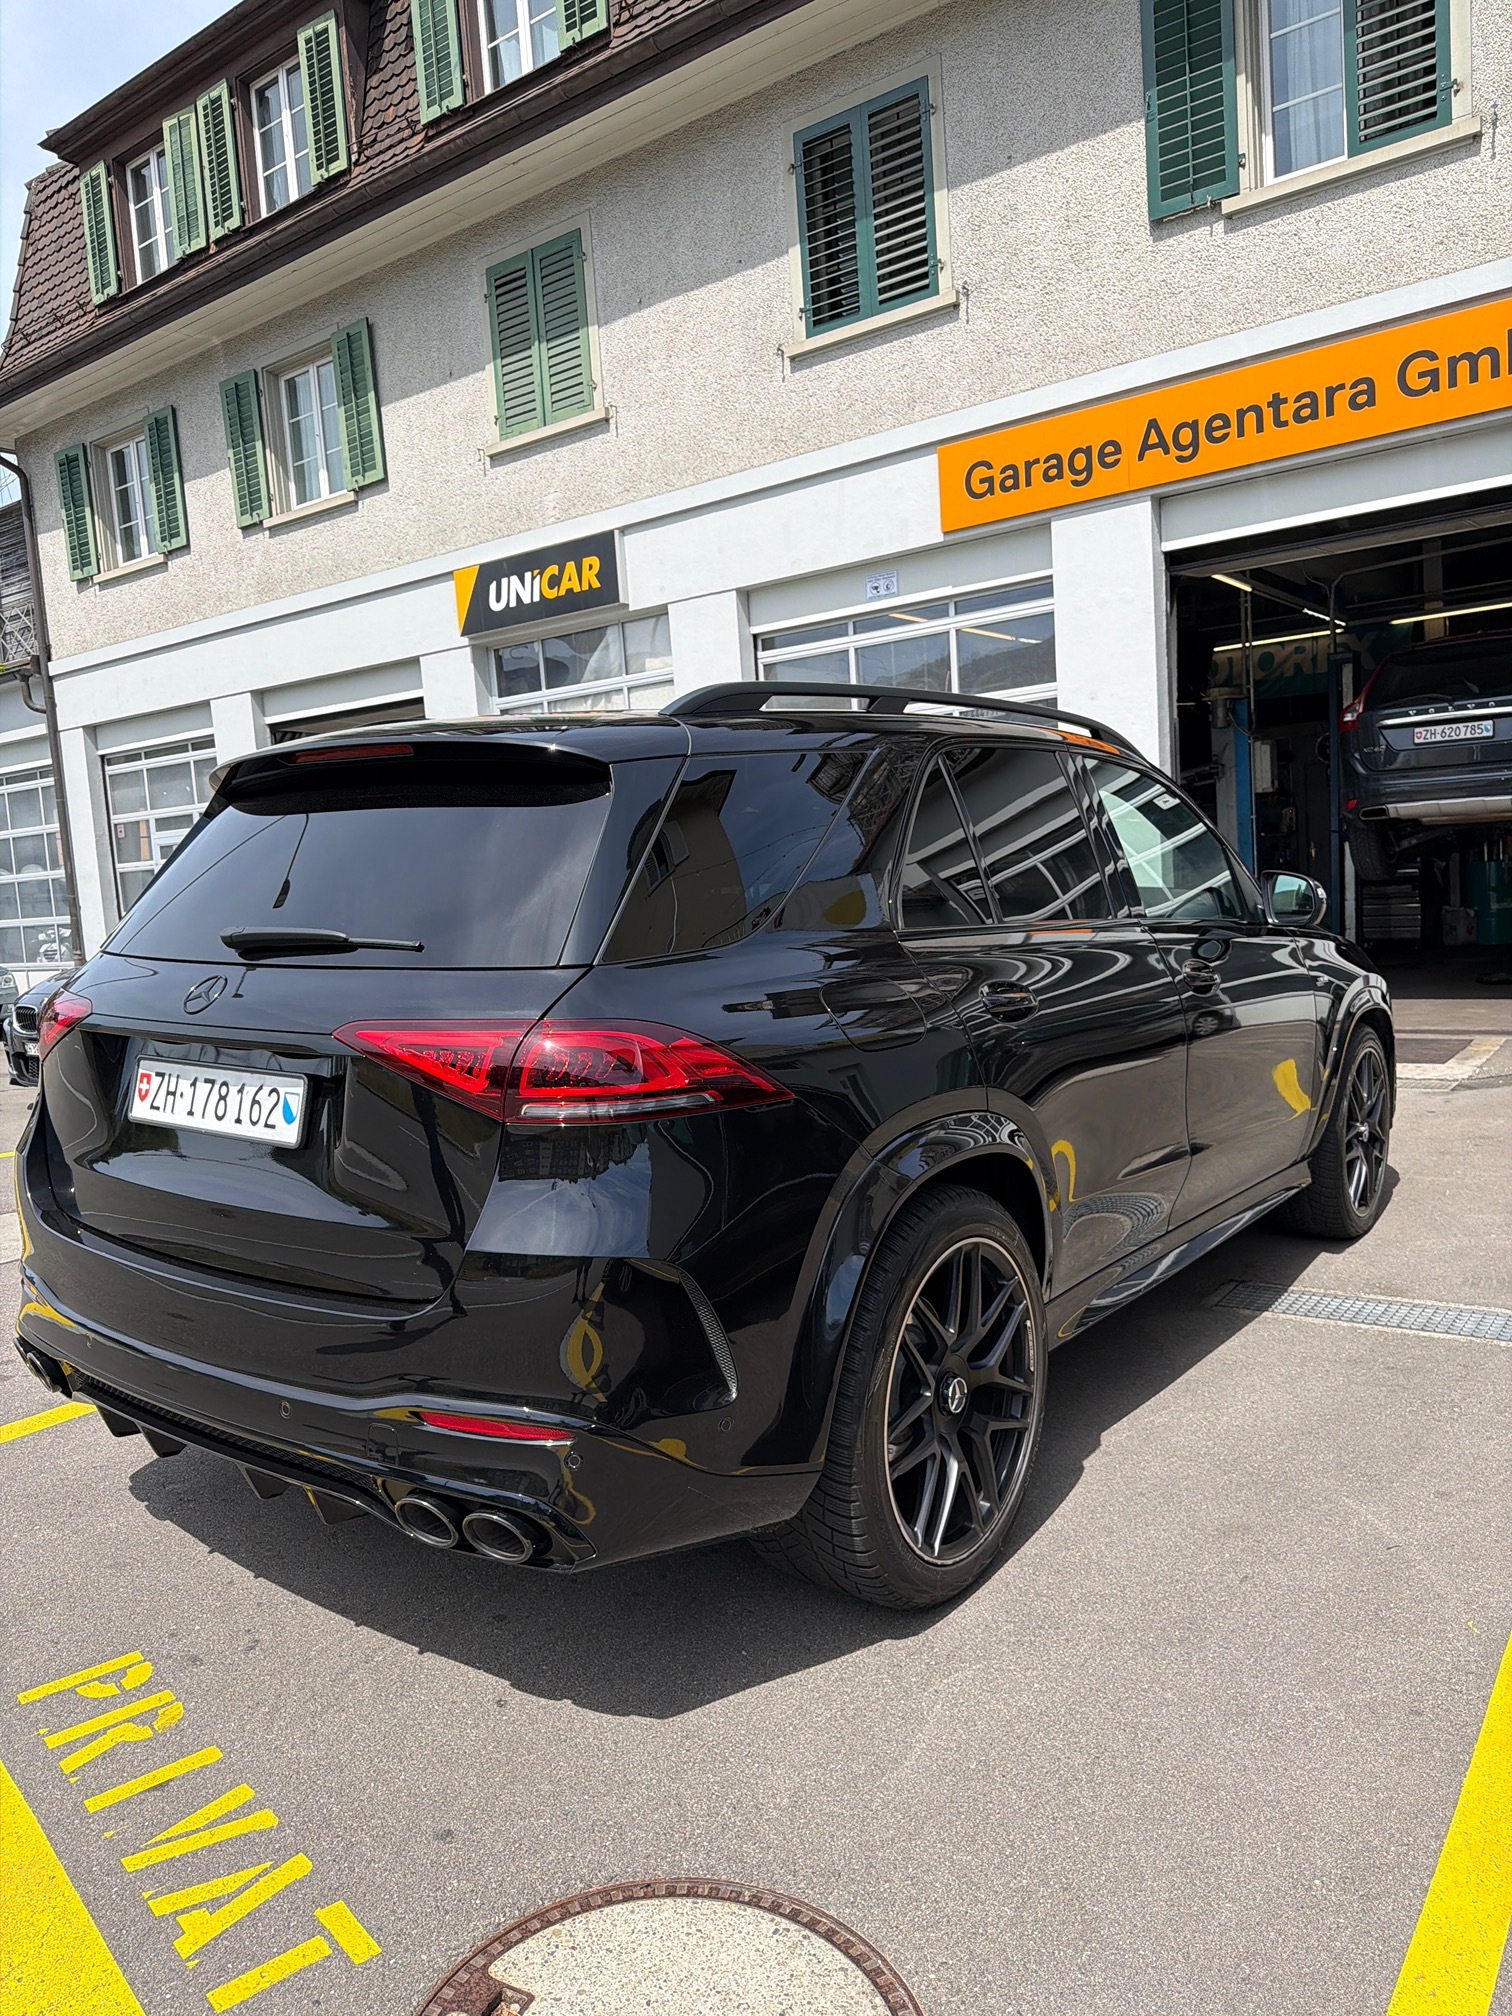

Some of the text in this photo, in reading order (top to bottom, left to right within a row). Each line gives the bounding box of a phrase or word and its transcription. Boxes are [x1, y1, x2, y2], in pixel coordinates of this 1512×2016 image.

[965, 328, 1512, 500] Garage Agentara Gm
[1408, 701, 1496, 716] VOLVO
[16, 1650, 383, 2013] PRIVAT
